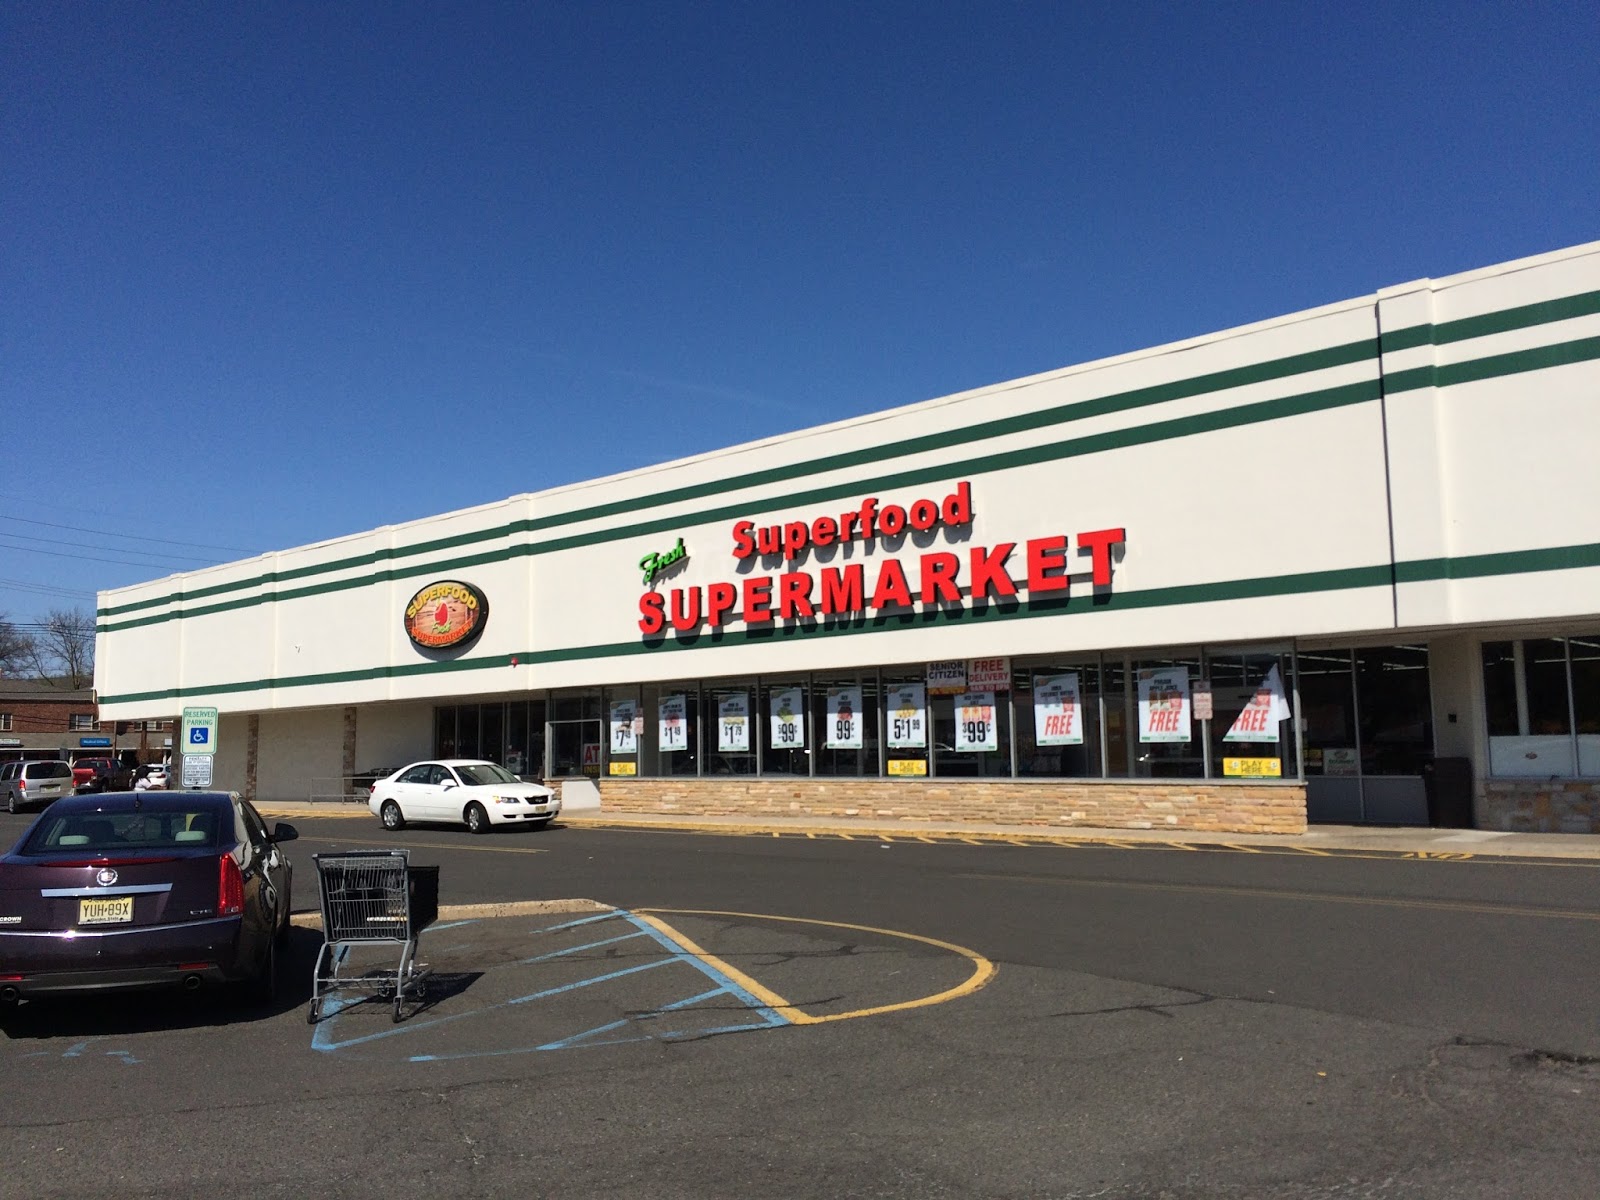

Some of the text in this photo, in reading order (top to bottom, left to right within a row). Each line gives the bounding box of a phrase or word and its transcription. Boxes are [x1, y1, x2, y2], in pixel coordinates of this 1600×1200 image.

[732, 481, 971, 561] Superfood
[639, 538, 687, 584] Fresh
[639, 527, 1126, 635] SUPERMARKET
[406, 585, 477, 619] SUPERFOOD
[411, 617, 474, 644] SUPERMARKET
[928, 670, 964, 680] CITIZEN
[929, 661, 963, 671] SENIOR
[969, 672, 1009, 682] DELIVERY
[973, 659, 1004, 672] FREE
[1044, 714, 1073, 736] FREE
[1148, 709, 1181, 732] FREE
